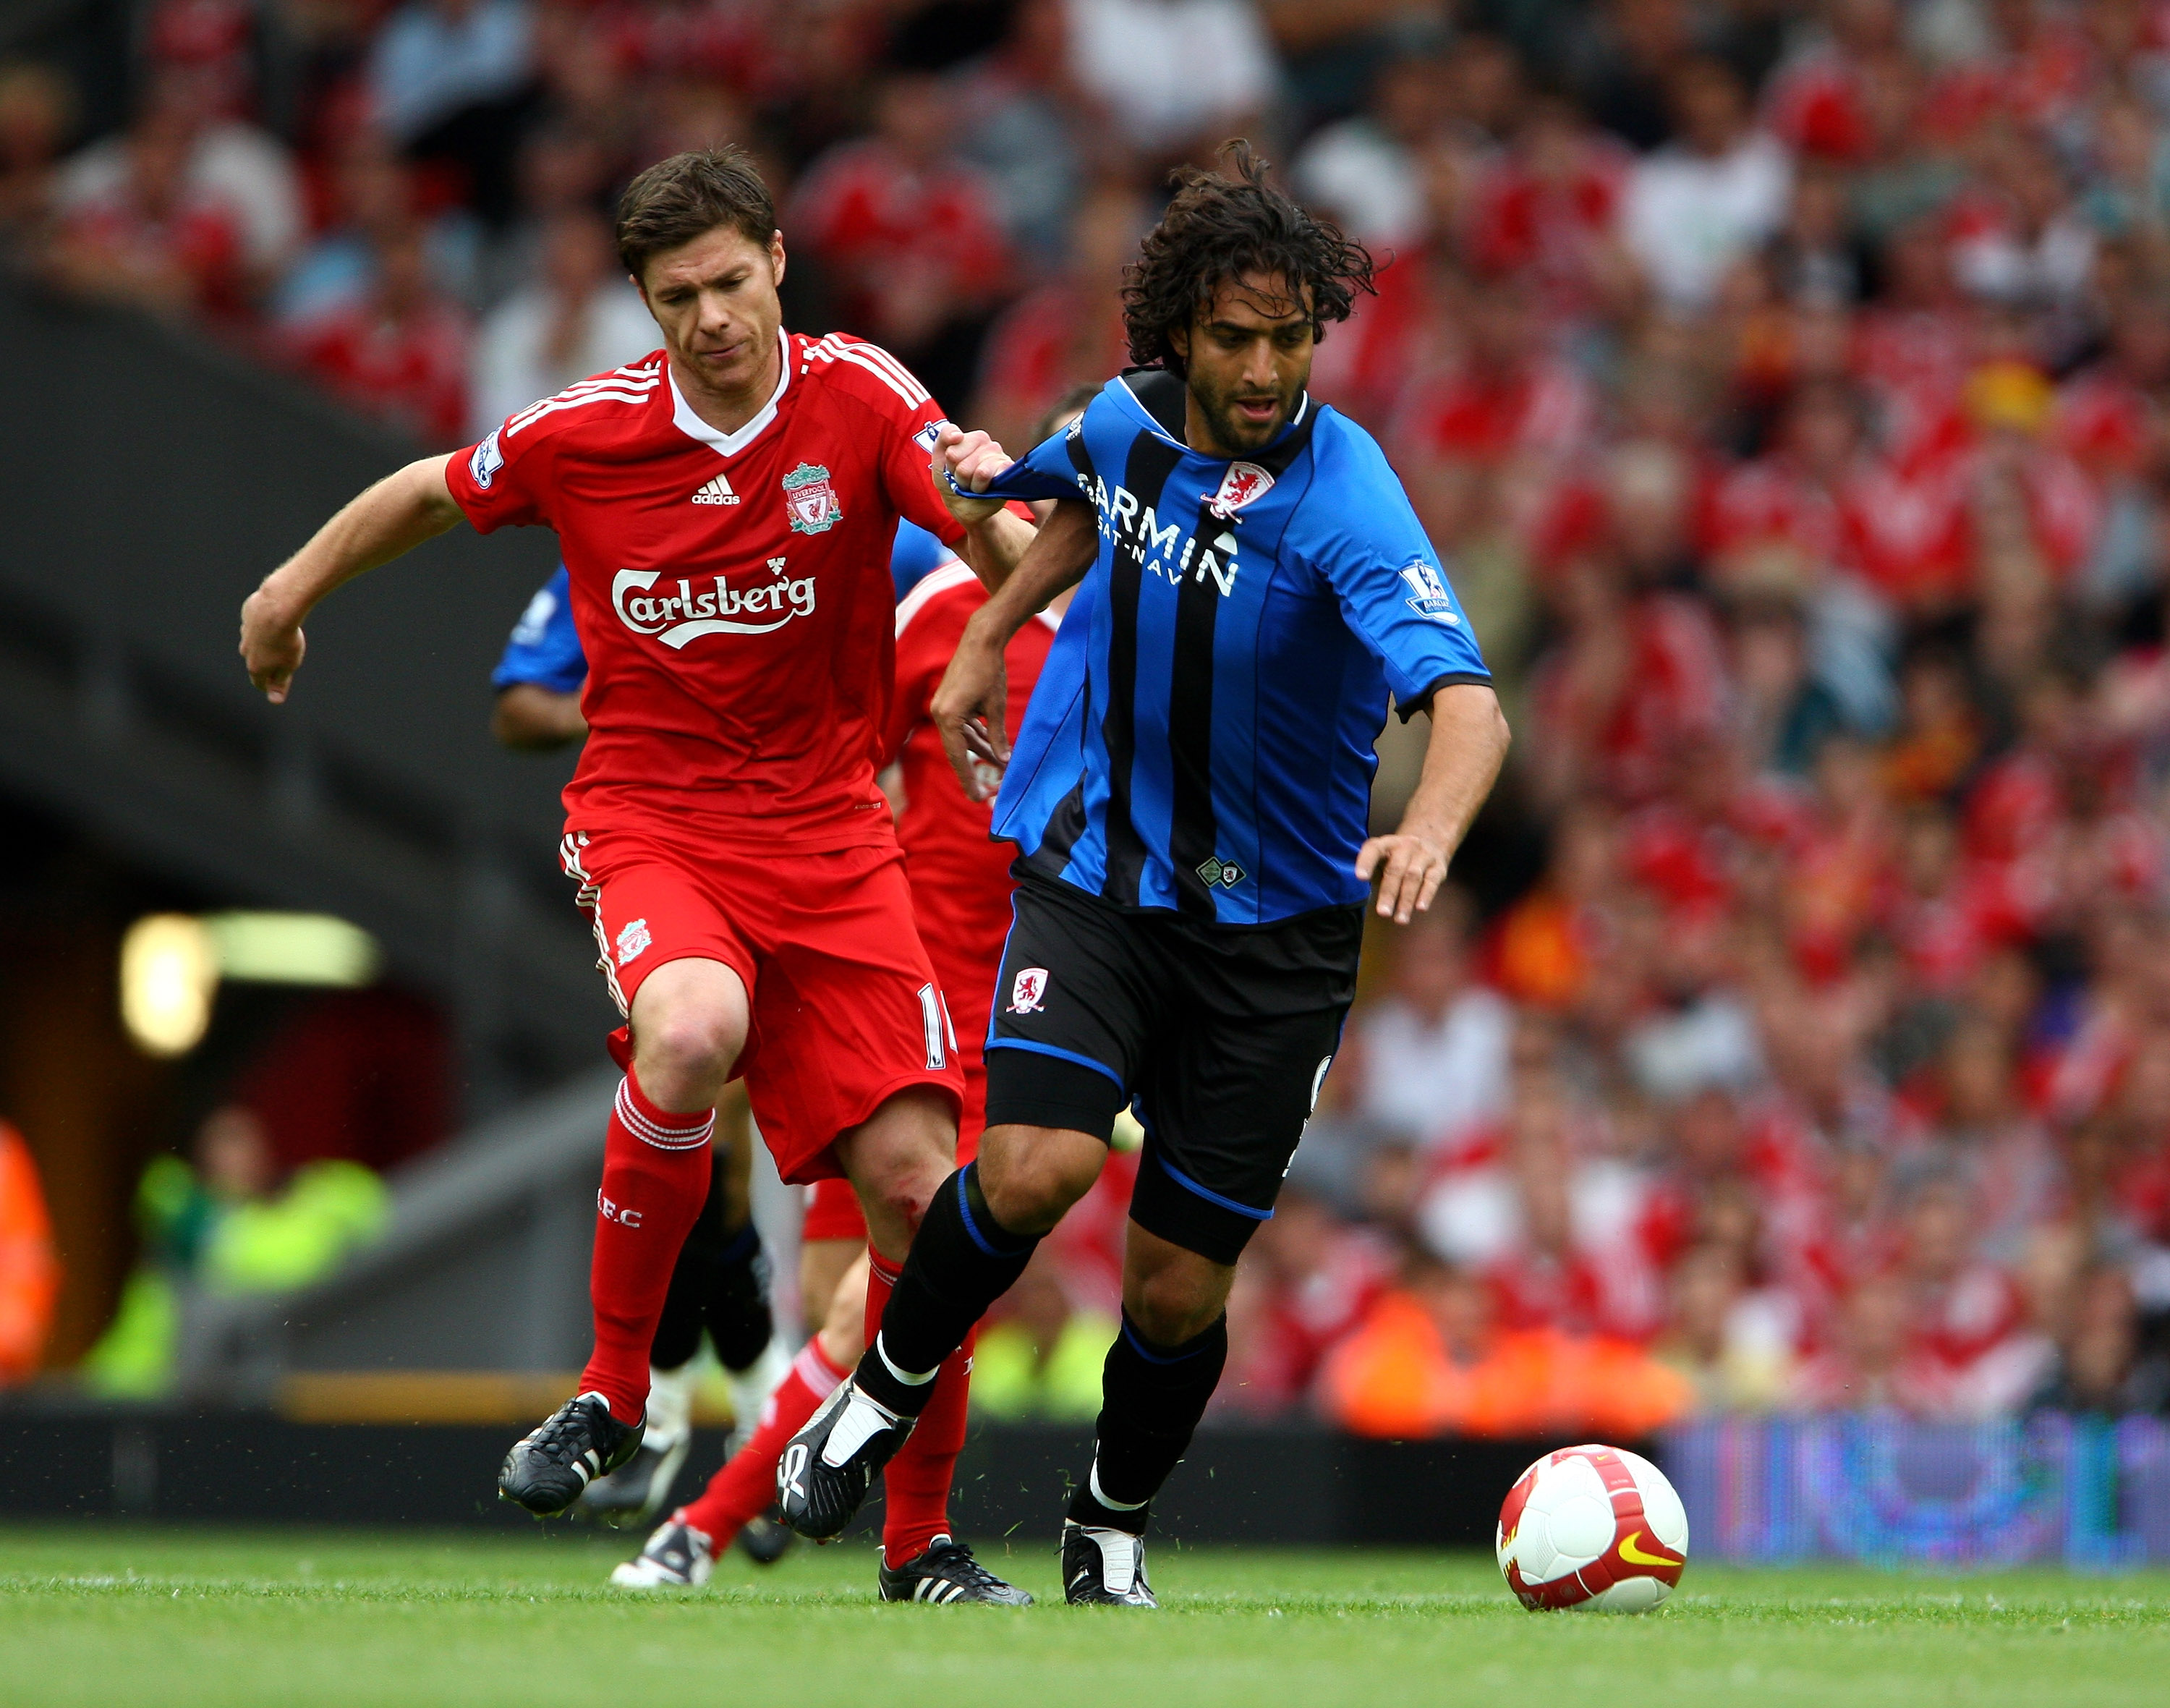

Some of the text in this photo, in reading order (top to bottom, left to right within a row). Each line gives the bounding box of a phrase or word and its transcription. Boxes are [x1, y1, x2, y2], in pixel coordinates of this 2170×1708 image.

[692, 493, 741, 505] adidas
[792, 485, 825, 499] LIVERPOOL
[1097, 514, 1183, 585] SAT-NAV
[612, 569, 816, 650] Carlsberg
